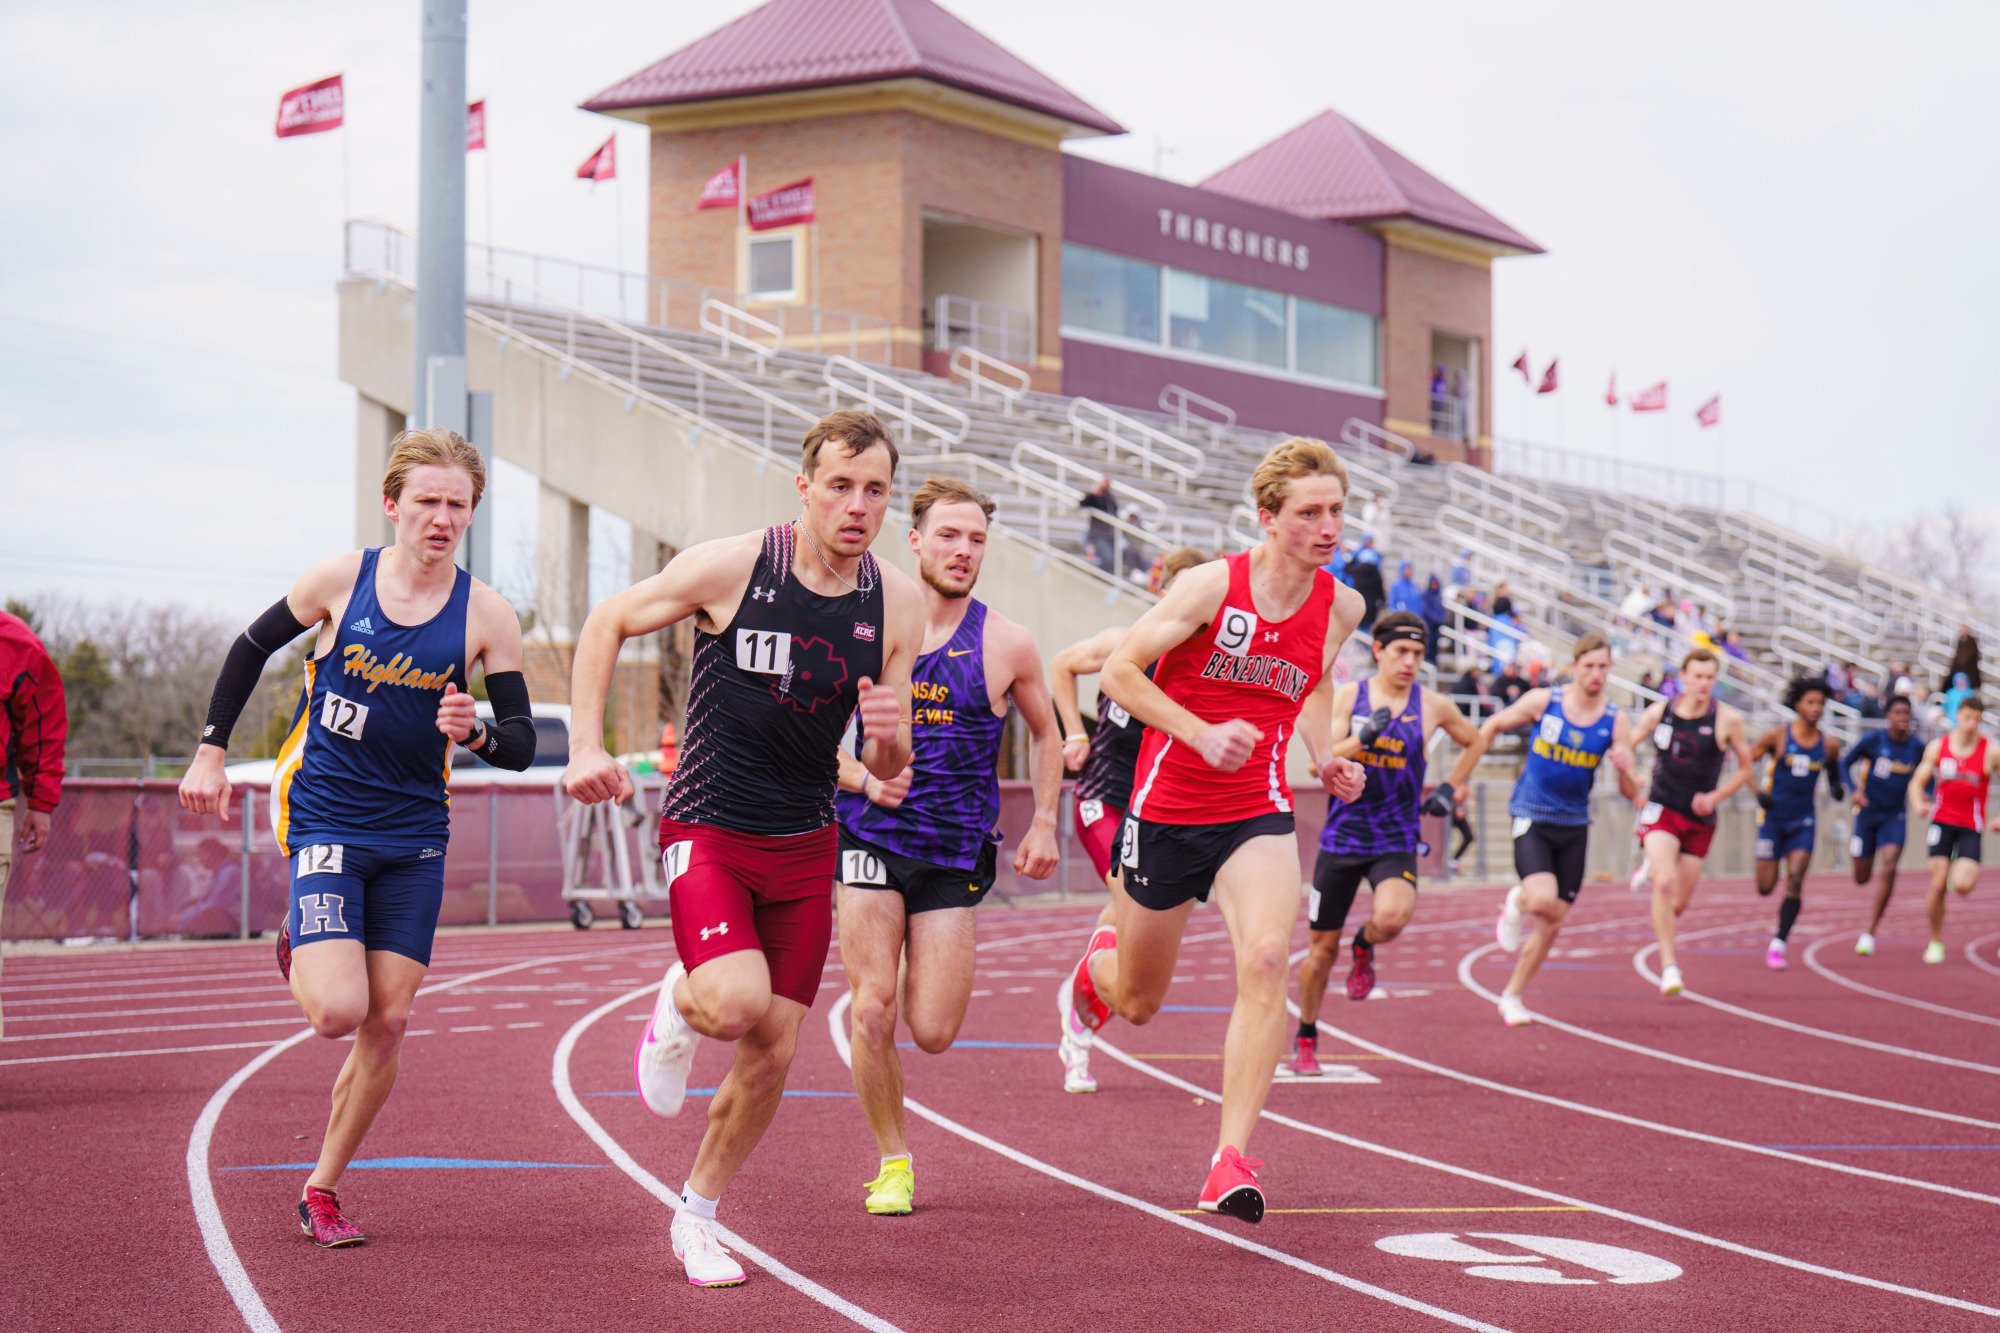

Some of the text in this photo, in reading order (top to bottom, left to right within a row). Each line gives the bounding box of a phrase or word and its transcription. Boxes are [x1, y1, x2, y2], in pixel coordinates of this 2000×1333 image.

[1158, 208, 1309, 272] THRESHERS
[350, 624, 375, 636] adidas
[1220, 613, 1249, 649] 9
[343, 643, 455, 694] Highland
[745, 632, 778, 671] 11
[911, 681, 949, 703] NSAS
[1200, 651, 1309, 703] BENEDICTINE
[330, 698, 358, 736] 12
[911, 708, 954, 725] EYAN
[1532, 736, 1600, 769] BETHAN
[304, 844, 334, 872] 12
[1124, 824, 1134, 860] 9
[849, 852, 879, 881] 10
[299, 893, 349, 936] H
